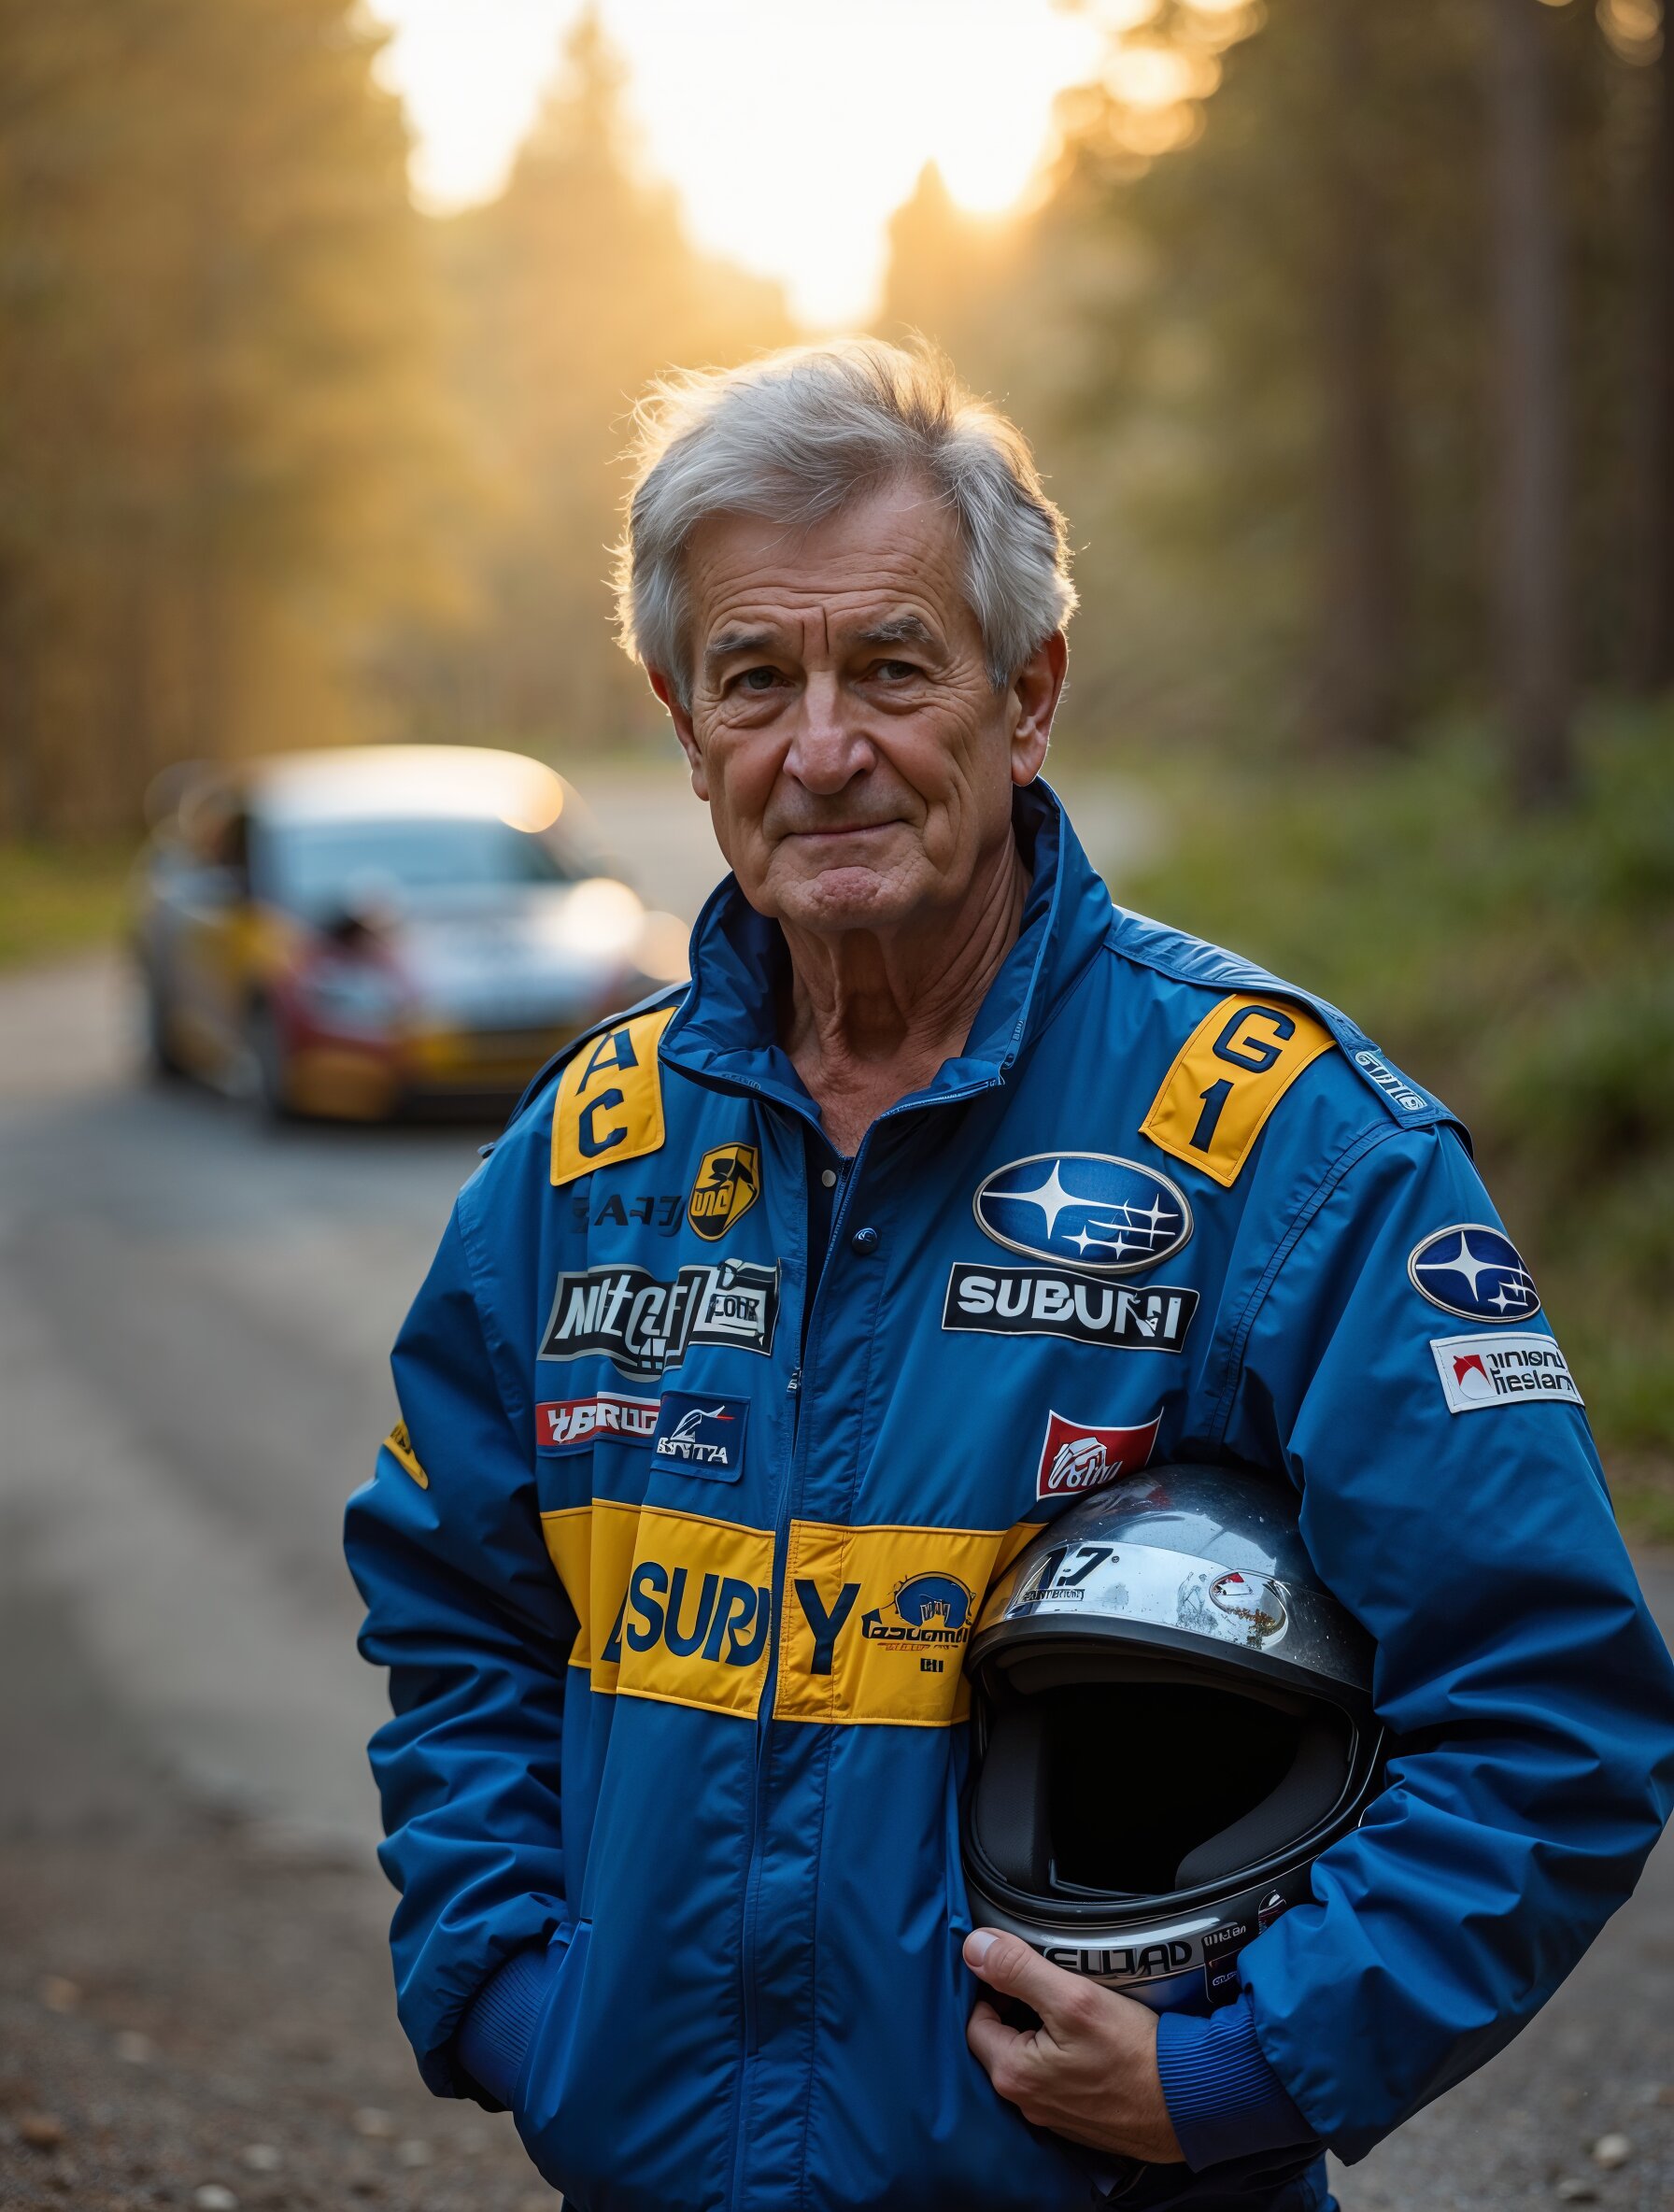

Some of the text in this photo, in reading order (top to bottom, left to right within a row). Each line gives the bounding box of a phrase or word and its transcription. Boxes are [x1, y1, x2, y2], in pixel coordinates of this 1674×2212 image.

[575, 1028, 639, 1097] A
[1213, 1005, 1297, 1073] G
[578, 1088, 629, 1158] C
[1189, 1078, 1235, 1154] 1
